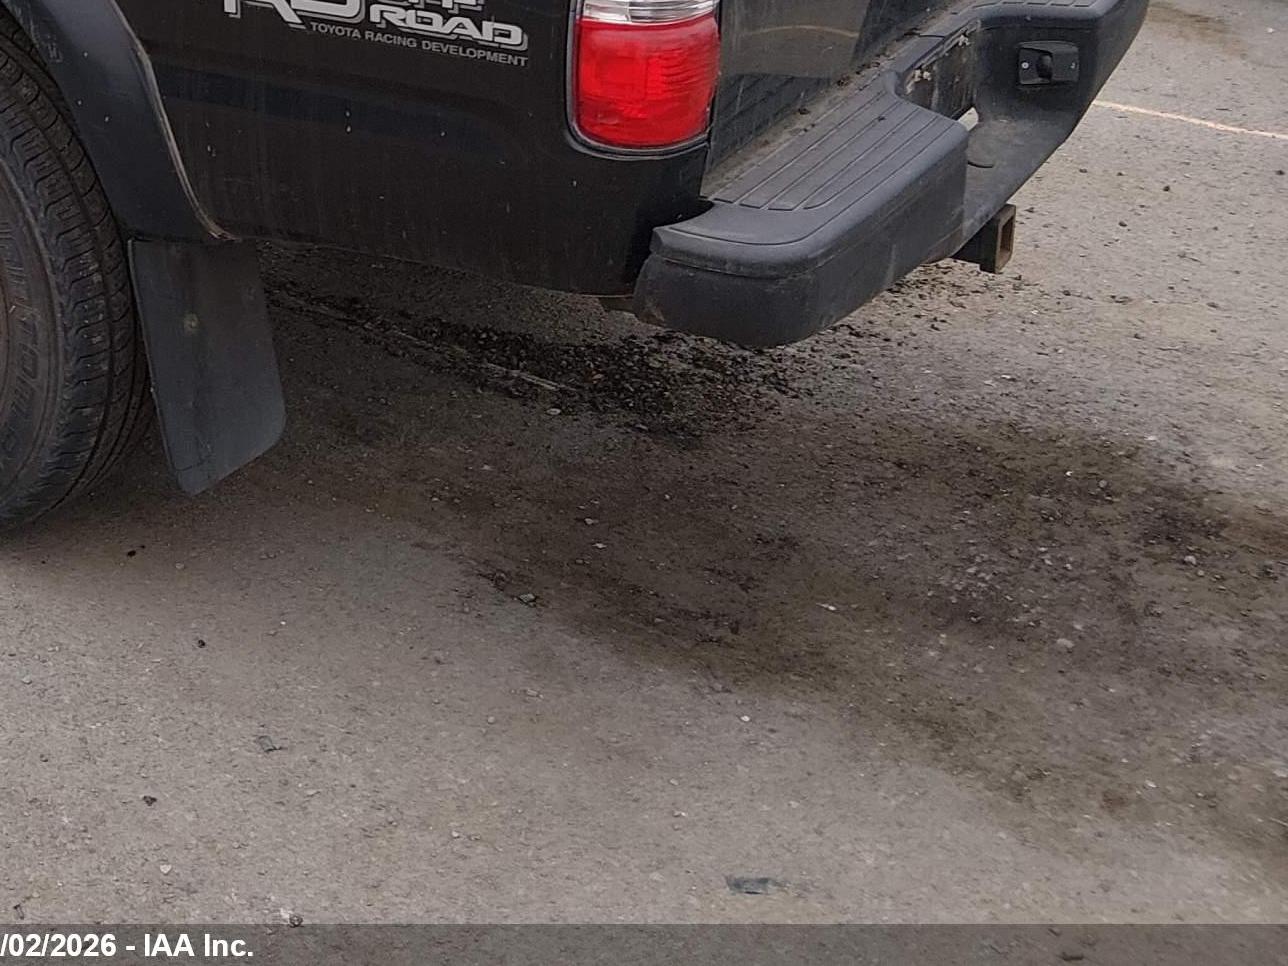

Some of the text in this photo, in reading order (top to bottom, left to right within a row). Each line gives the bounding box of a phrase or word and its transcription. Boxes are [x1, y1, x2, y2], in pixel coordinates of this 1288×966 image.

[310, 21, 529, 67] TOYOTA RACING DEVELOPMENT
[369, 3, 529, 51] ROAD
